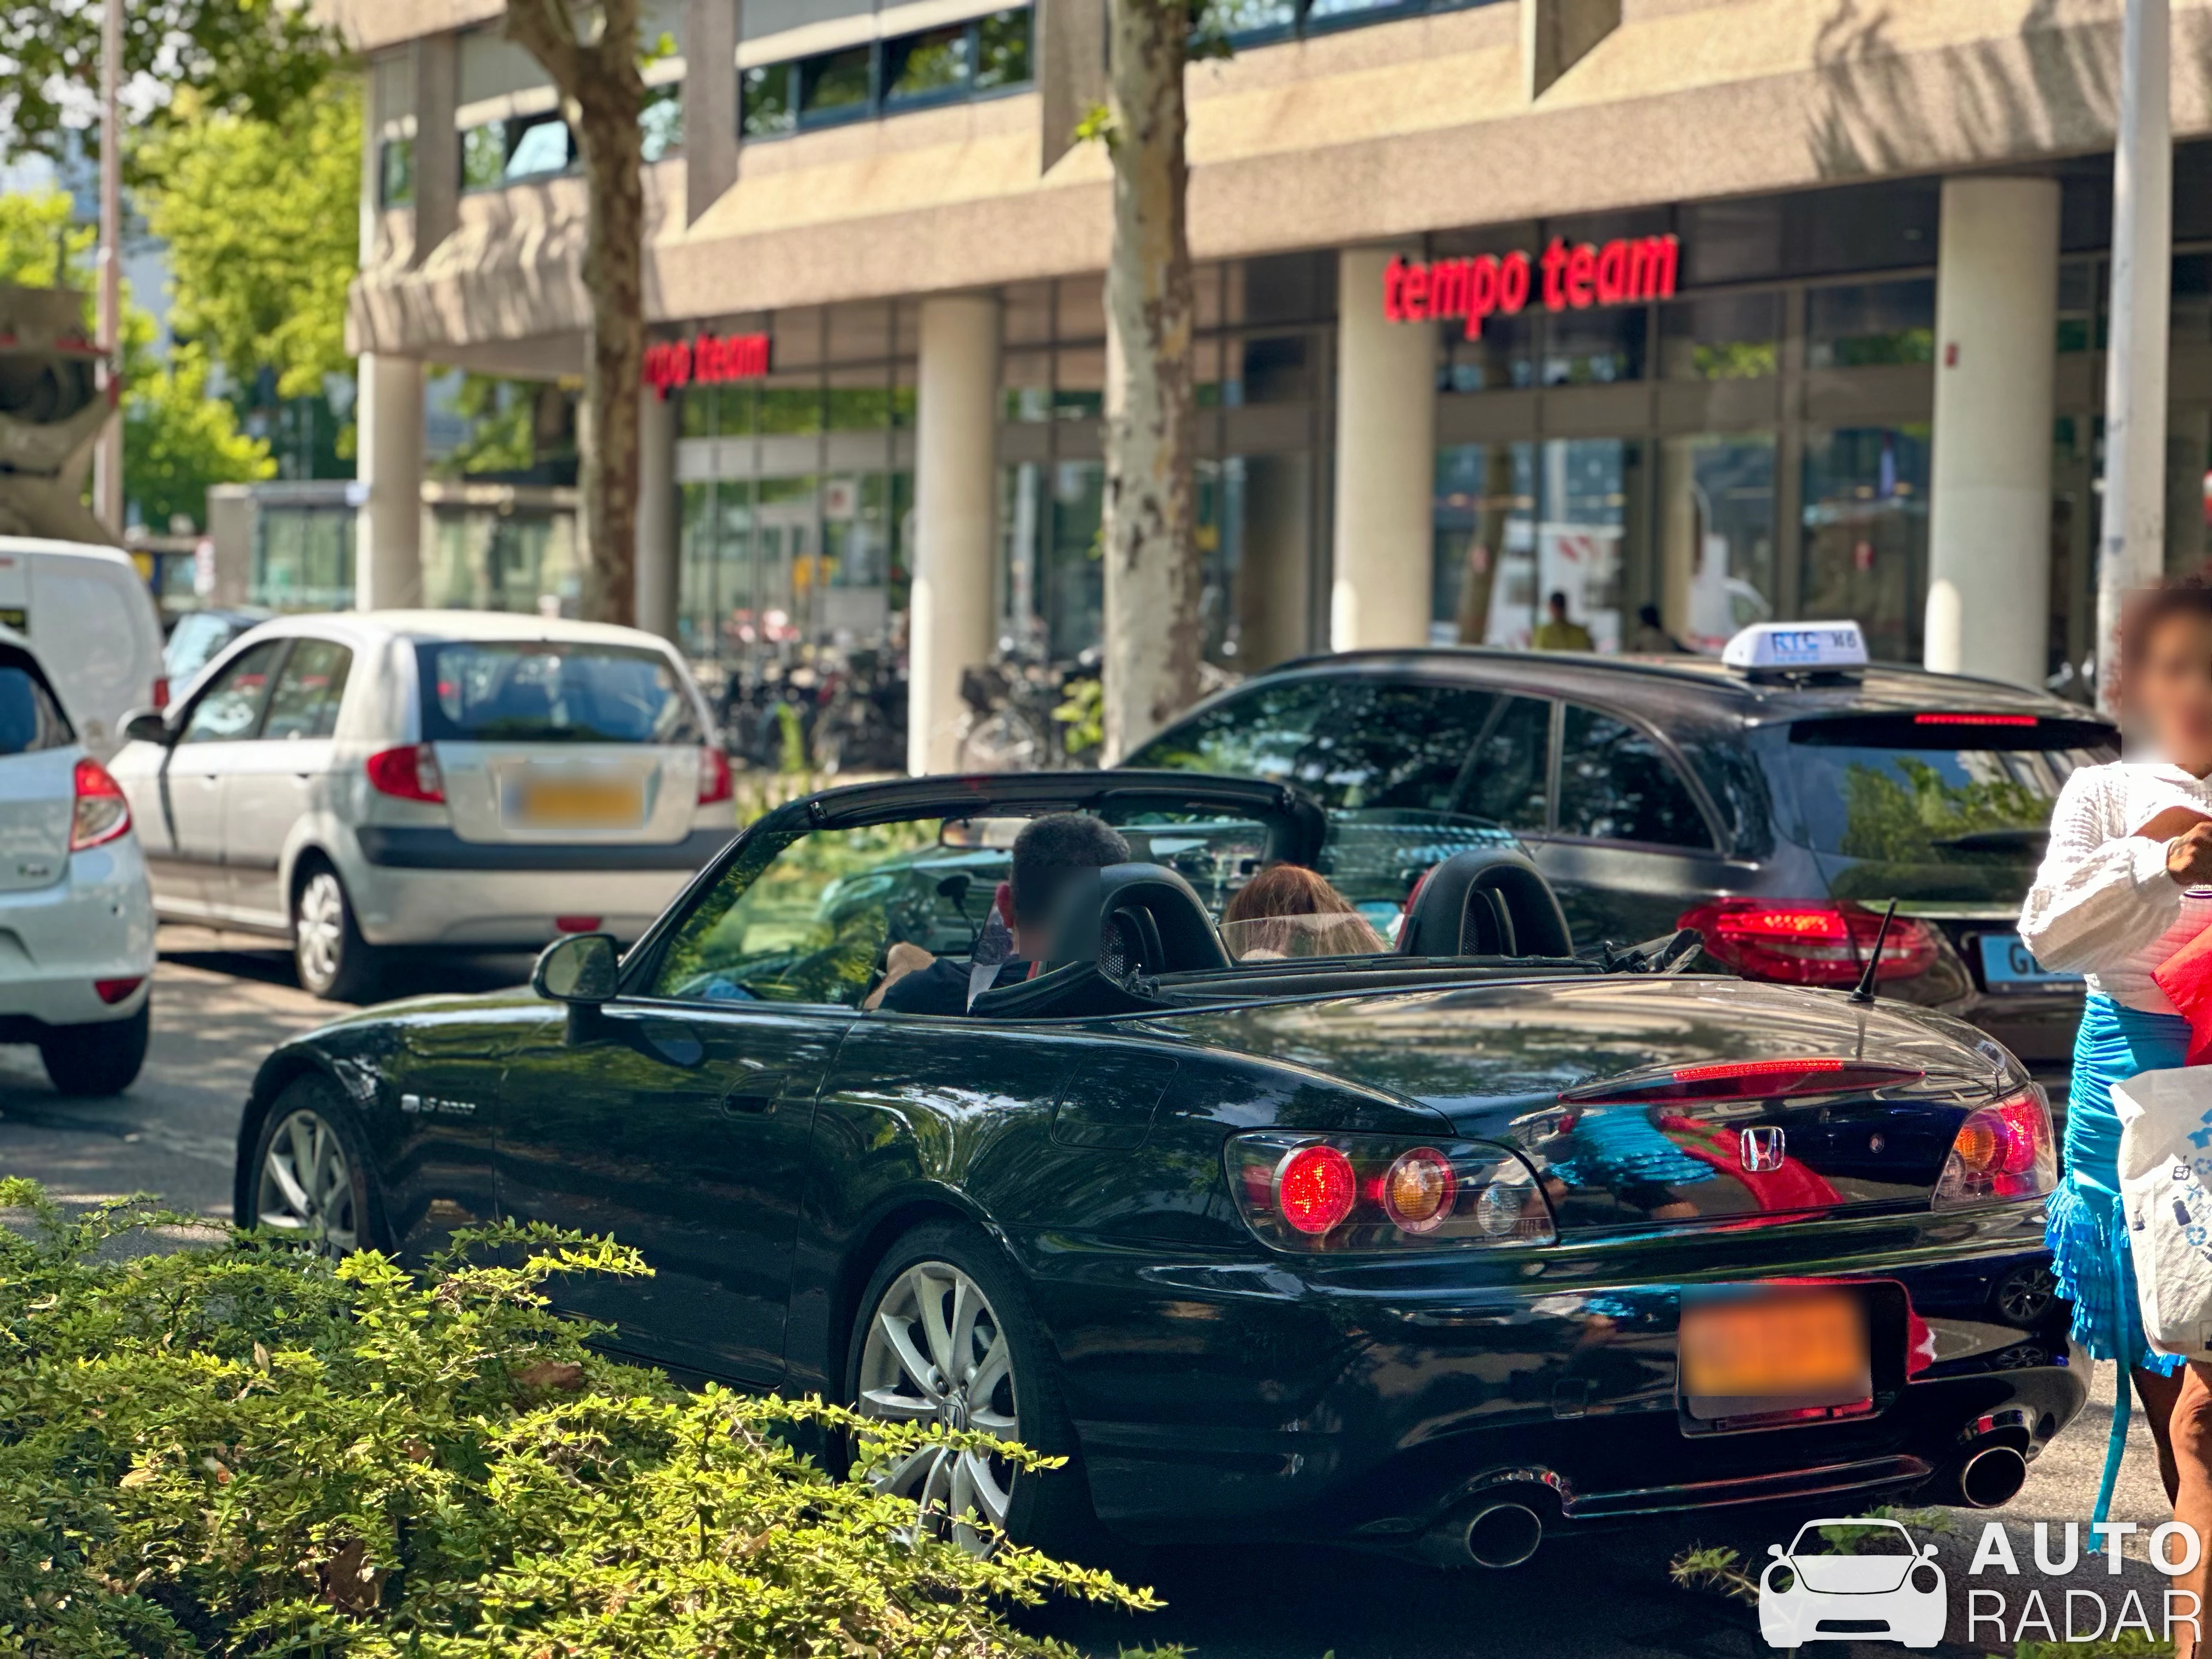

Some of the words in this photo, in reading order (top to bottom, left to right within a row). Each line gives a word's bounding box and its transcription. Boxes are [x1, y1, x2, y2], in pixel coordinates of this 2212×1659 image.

[1384, 251, 1530, 341] tempo
[1541, 233, 1678, 311] team
[693, 332, 768, 384] team
[1772, 632, 1818, 651] RTC
